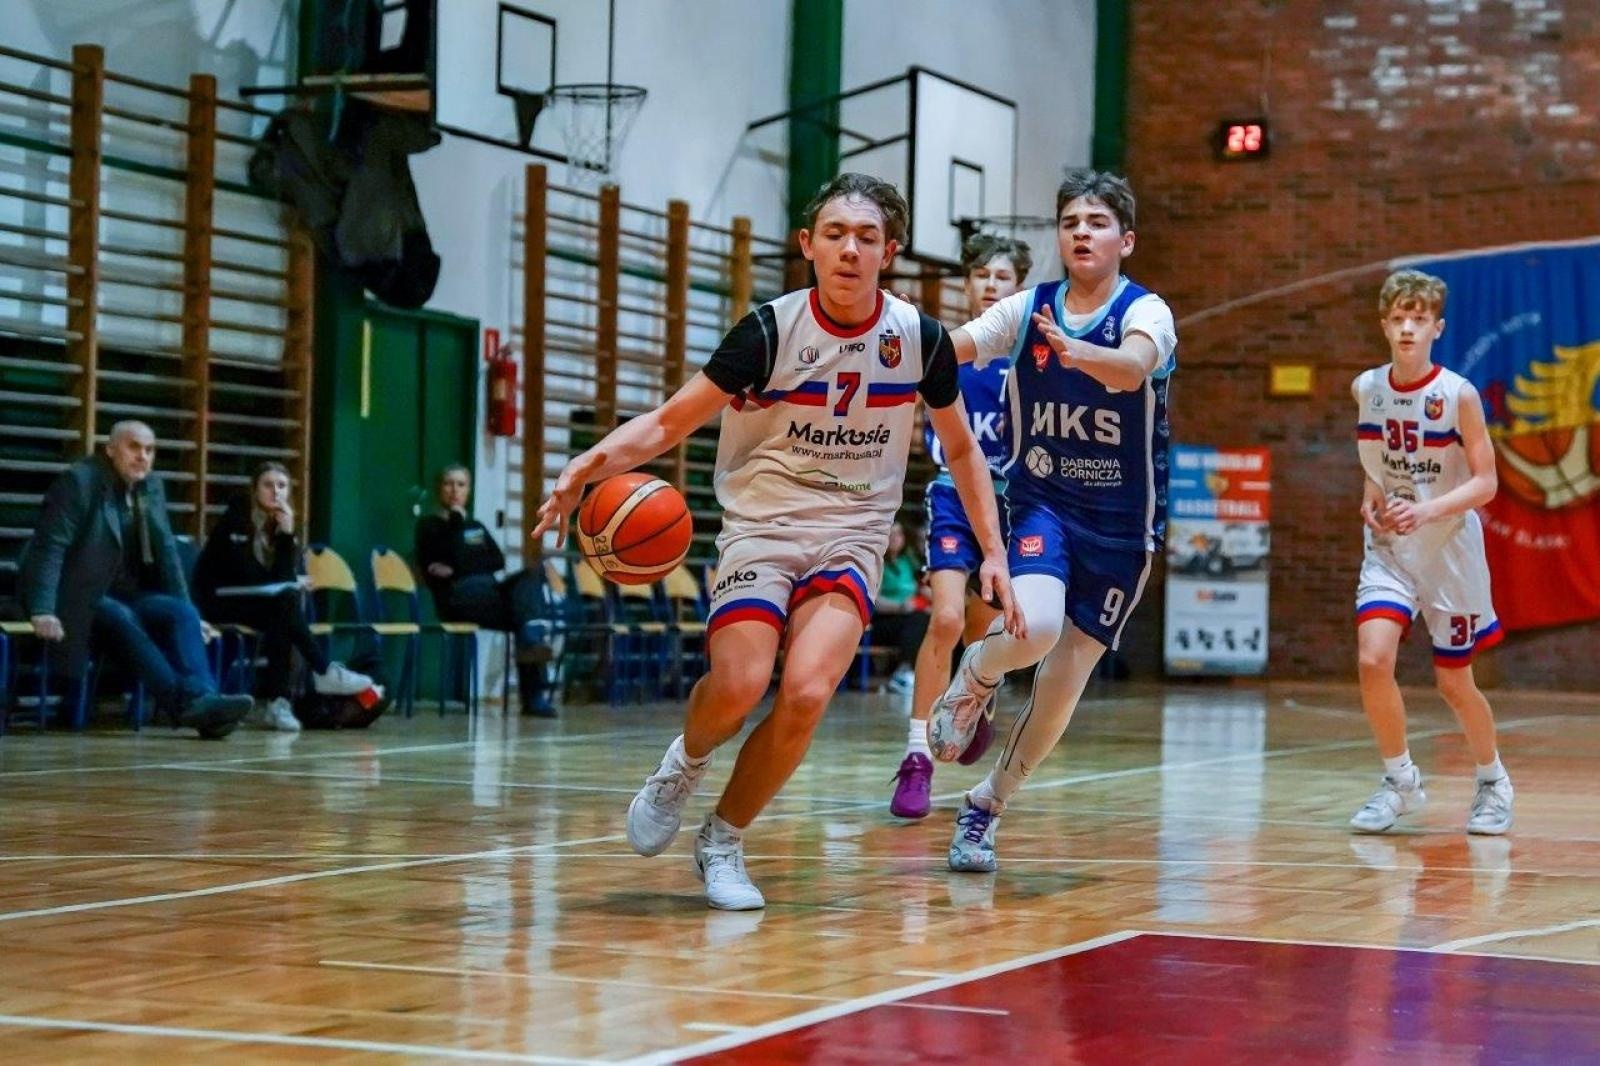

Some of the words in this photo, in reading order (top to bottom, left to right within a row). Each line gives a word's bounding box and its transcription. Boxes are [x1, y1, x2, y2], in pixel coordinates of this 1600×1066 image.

[1228, 125, 1262, 152] 22
[833, 372, 861, 417] 7
[1031, 401, 1121, 446] MKS
[1099, 587, 1125, 627] 9
